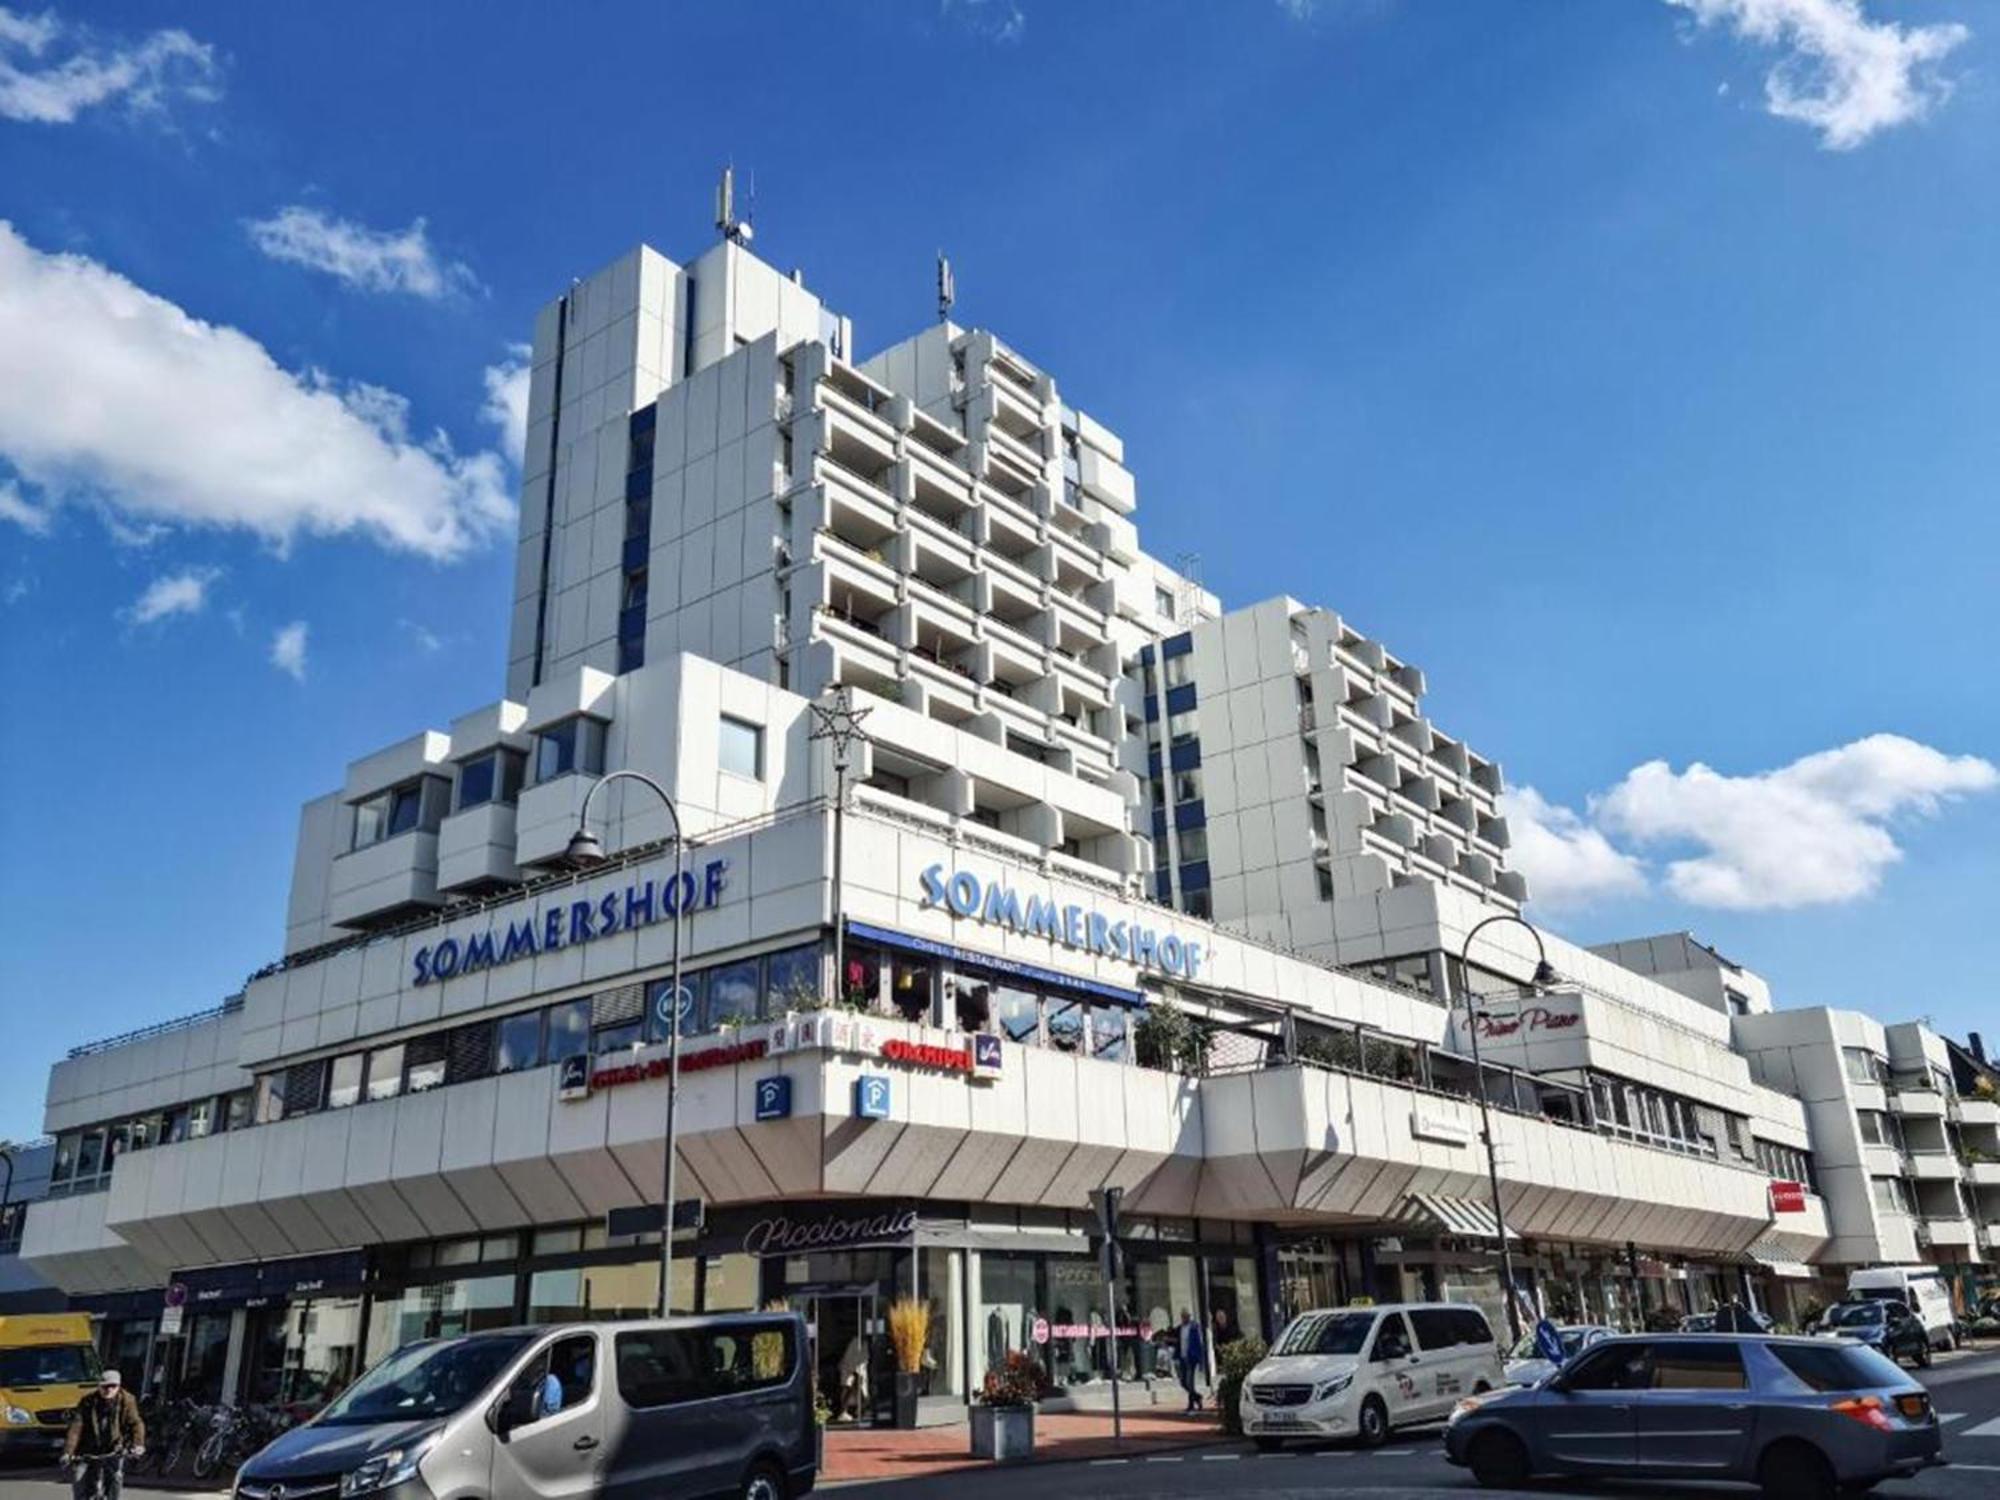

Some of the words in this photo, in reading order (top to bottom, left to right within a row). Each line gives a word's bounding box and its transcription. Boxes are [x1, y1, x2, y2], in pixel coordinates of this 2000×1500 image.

[412, 859, 726, 987] SOMMERSHOF
[919, 864, 1202, 979] SOMMERSHOF
[763, 1088, 776, 1109] P
[870, 1086, 882, 1105] P
